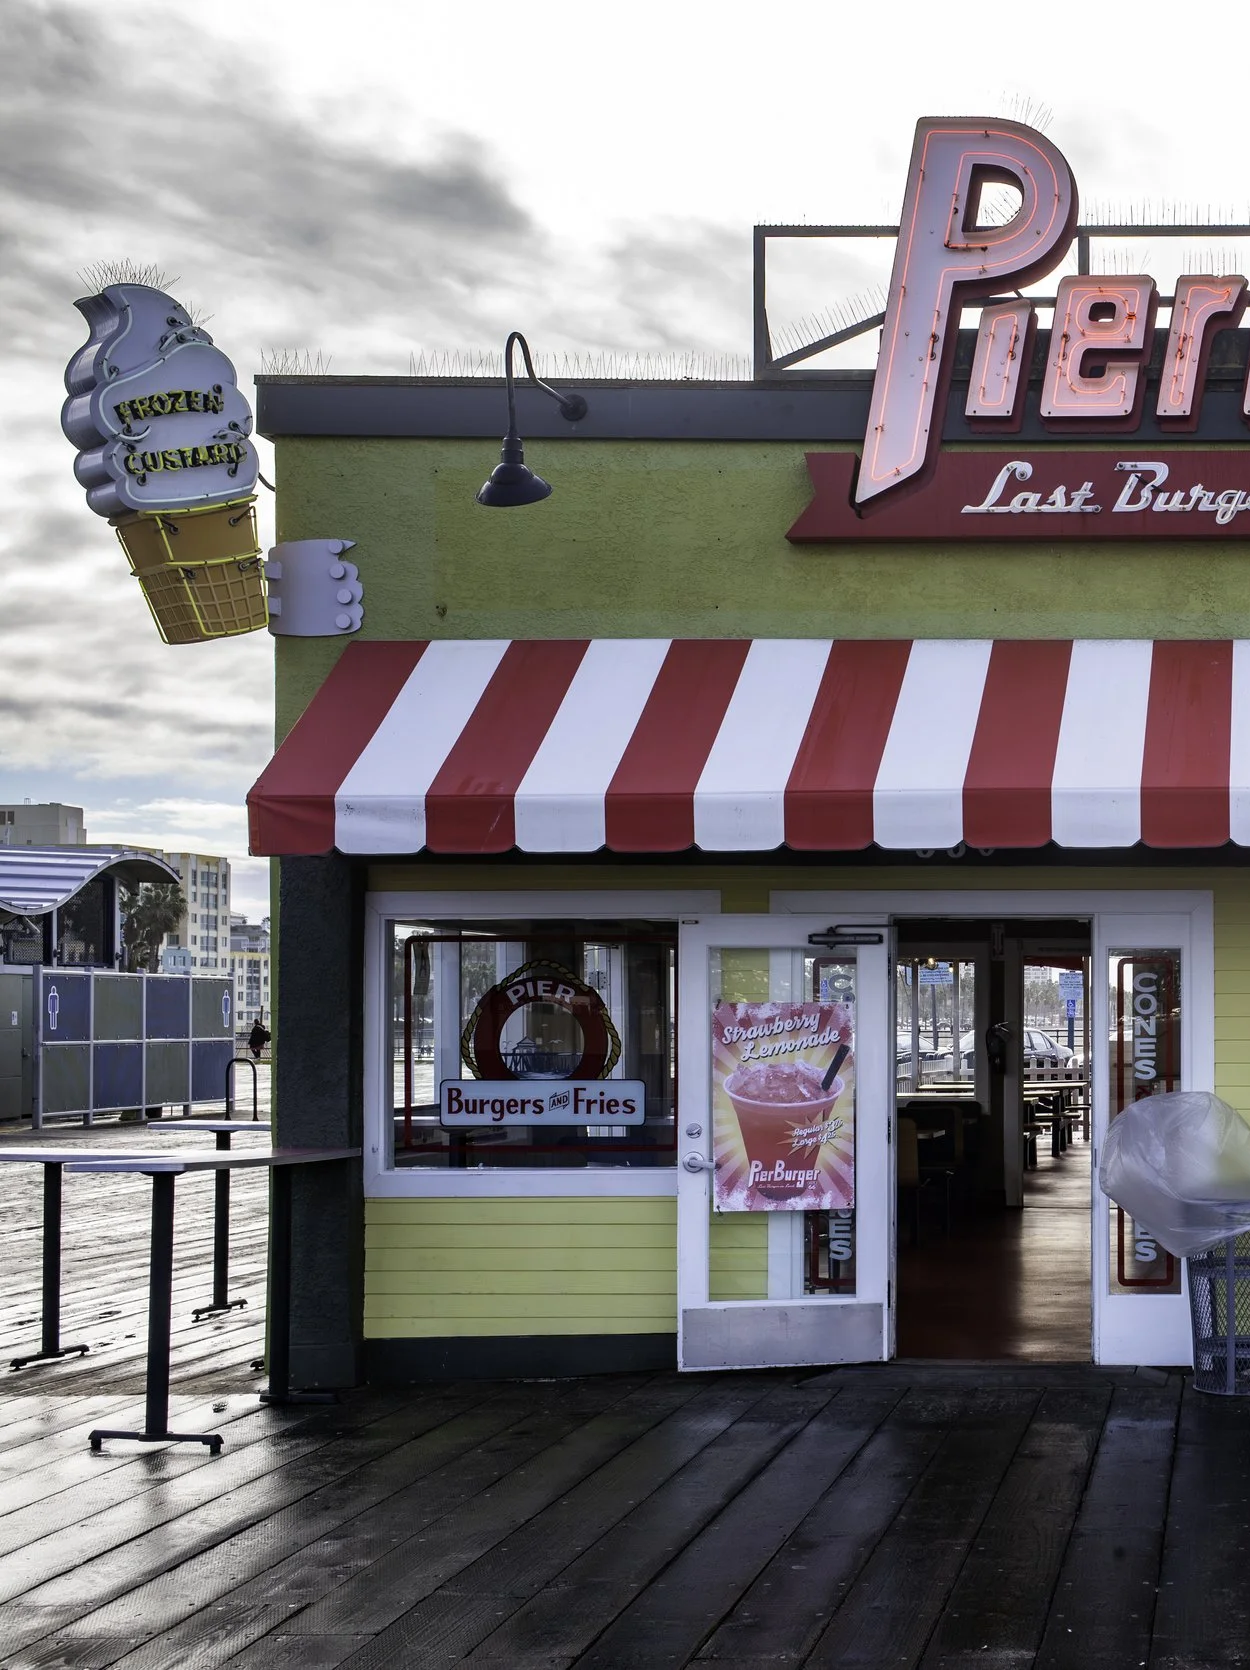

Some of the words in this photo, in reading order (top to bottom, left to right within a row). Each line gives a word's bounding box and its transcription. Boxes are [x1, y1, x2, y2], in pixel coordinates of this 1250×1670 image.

[114, 390, 224, 424] FROZEN
[124, 443, 247, 475] CUSTARD
[961, 460, 1101, 514] Last
[506, 980, 575, 1006] PIER
[722, 1013, 821, 1045] Strawberry
[1133, 972, 1158, 1080] CONES
[741, 1027, 840, 1062] Lemonade
[447, 1087, 545, 1122] Burgers
[551, 1095, 568, 1108] AND
[573, 1087, 636, 1115] Fries
[792, 1124, 823, 1137] Regular
[792, 1137, 817, 1147] Large
